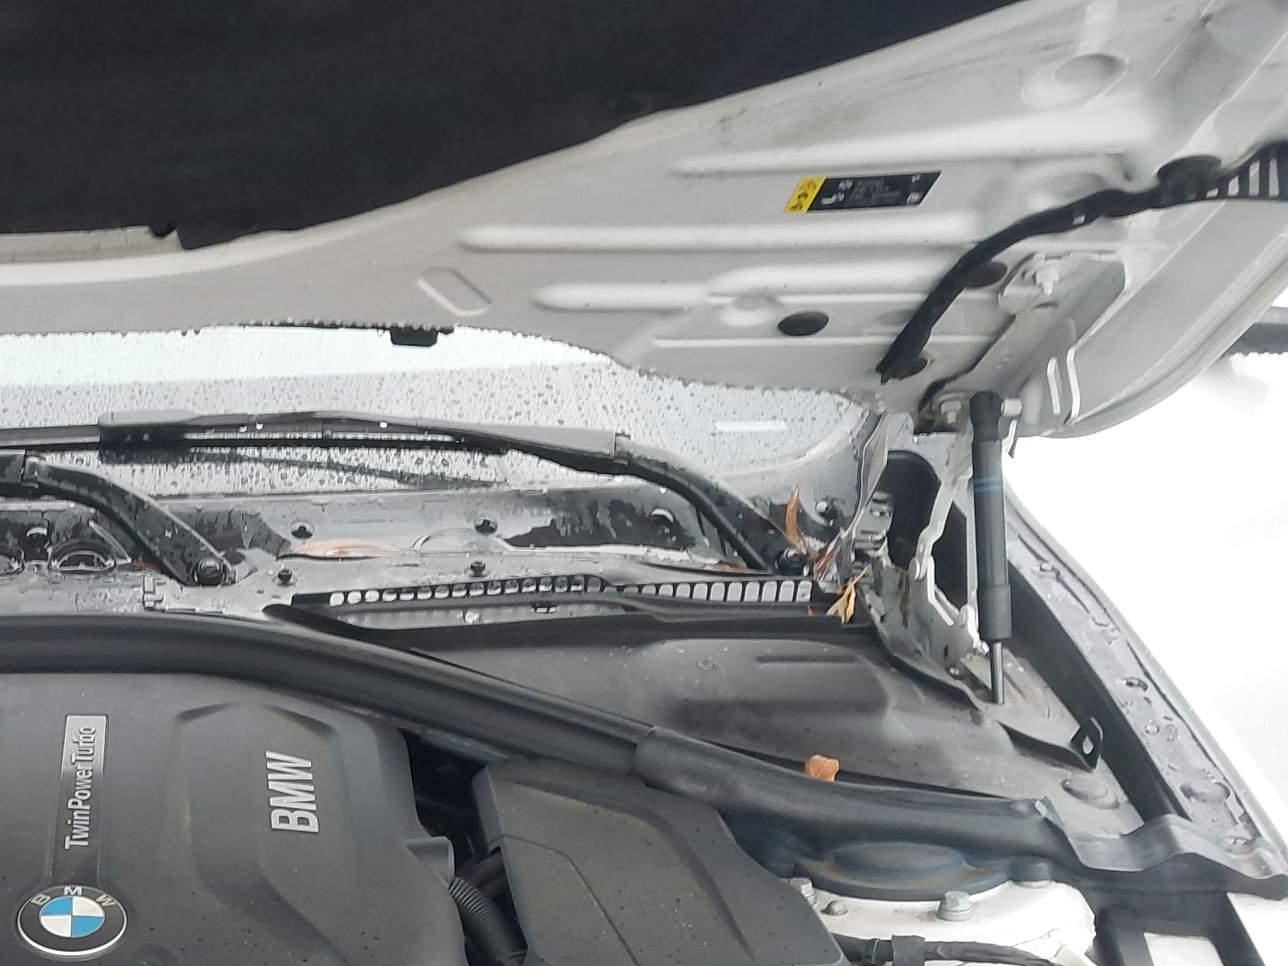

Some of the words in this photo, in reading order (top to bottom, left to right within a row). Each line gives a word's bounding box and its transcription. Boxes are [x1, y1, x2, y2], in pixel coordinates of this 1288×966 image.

[71, 726, 97, 764] Turbo
[64, 764, 95, 850] TwinPower
[265, 751, 319, 833] BMW
[30, 885, 117, 907] BMW
